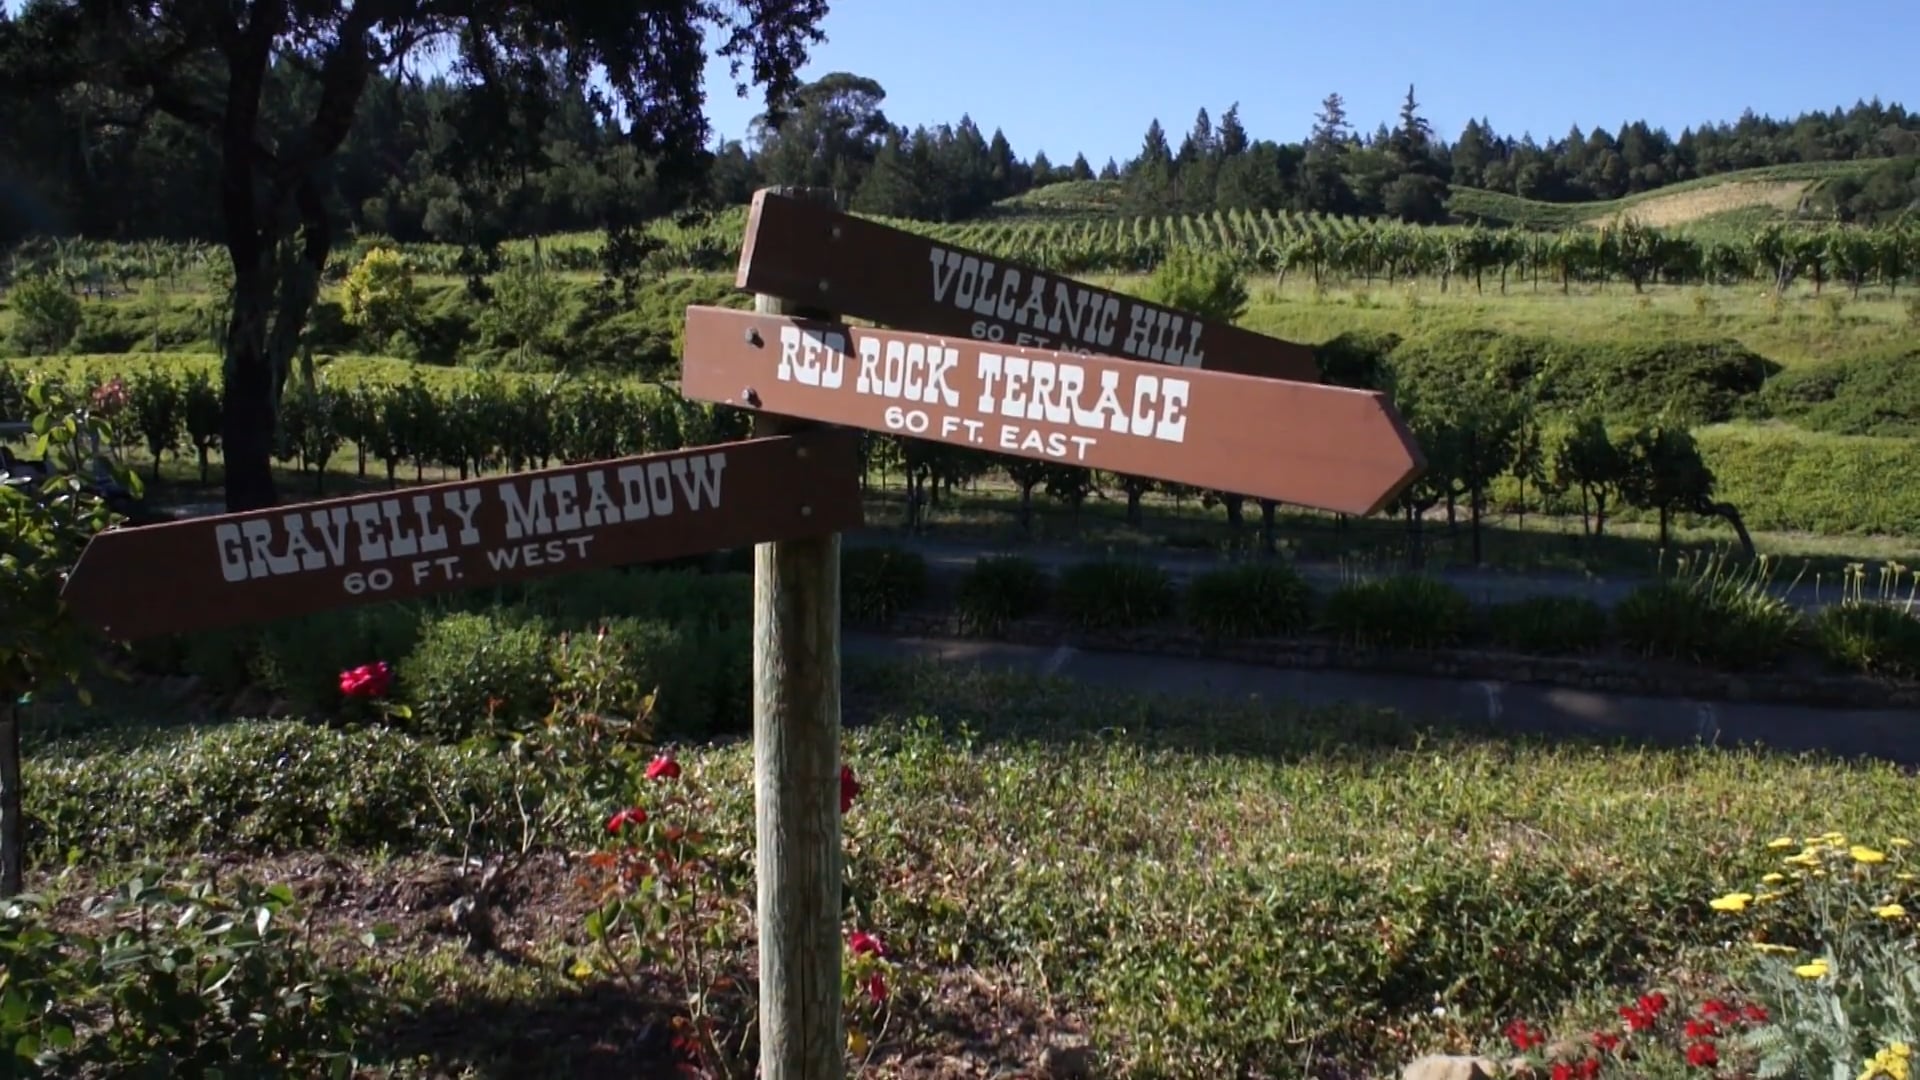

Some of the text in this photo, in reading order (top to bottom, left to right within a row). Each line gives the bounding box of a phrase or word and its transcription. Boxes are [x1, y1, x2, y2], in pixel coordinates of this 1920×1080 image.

[930, 248, 1204, 368] VOLCANIC HILL
[971, 320, 1004, 341] 60
[778, 326, 1191, 443] RED ROCK TERRACE
[885, 407, 1097, 460] 60 FT. EAST
[216, 454, 727, 583] GRAVELLY MEADOW
[344, 535, 594, 594] 60 FT. WEST
